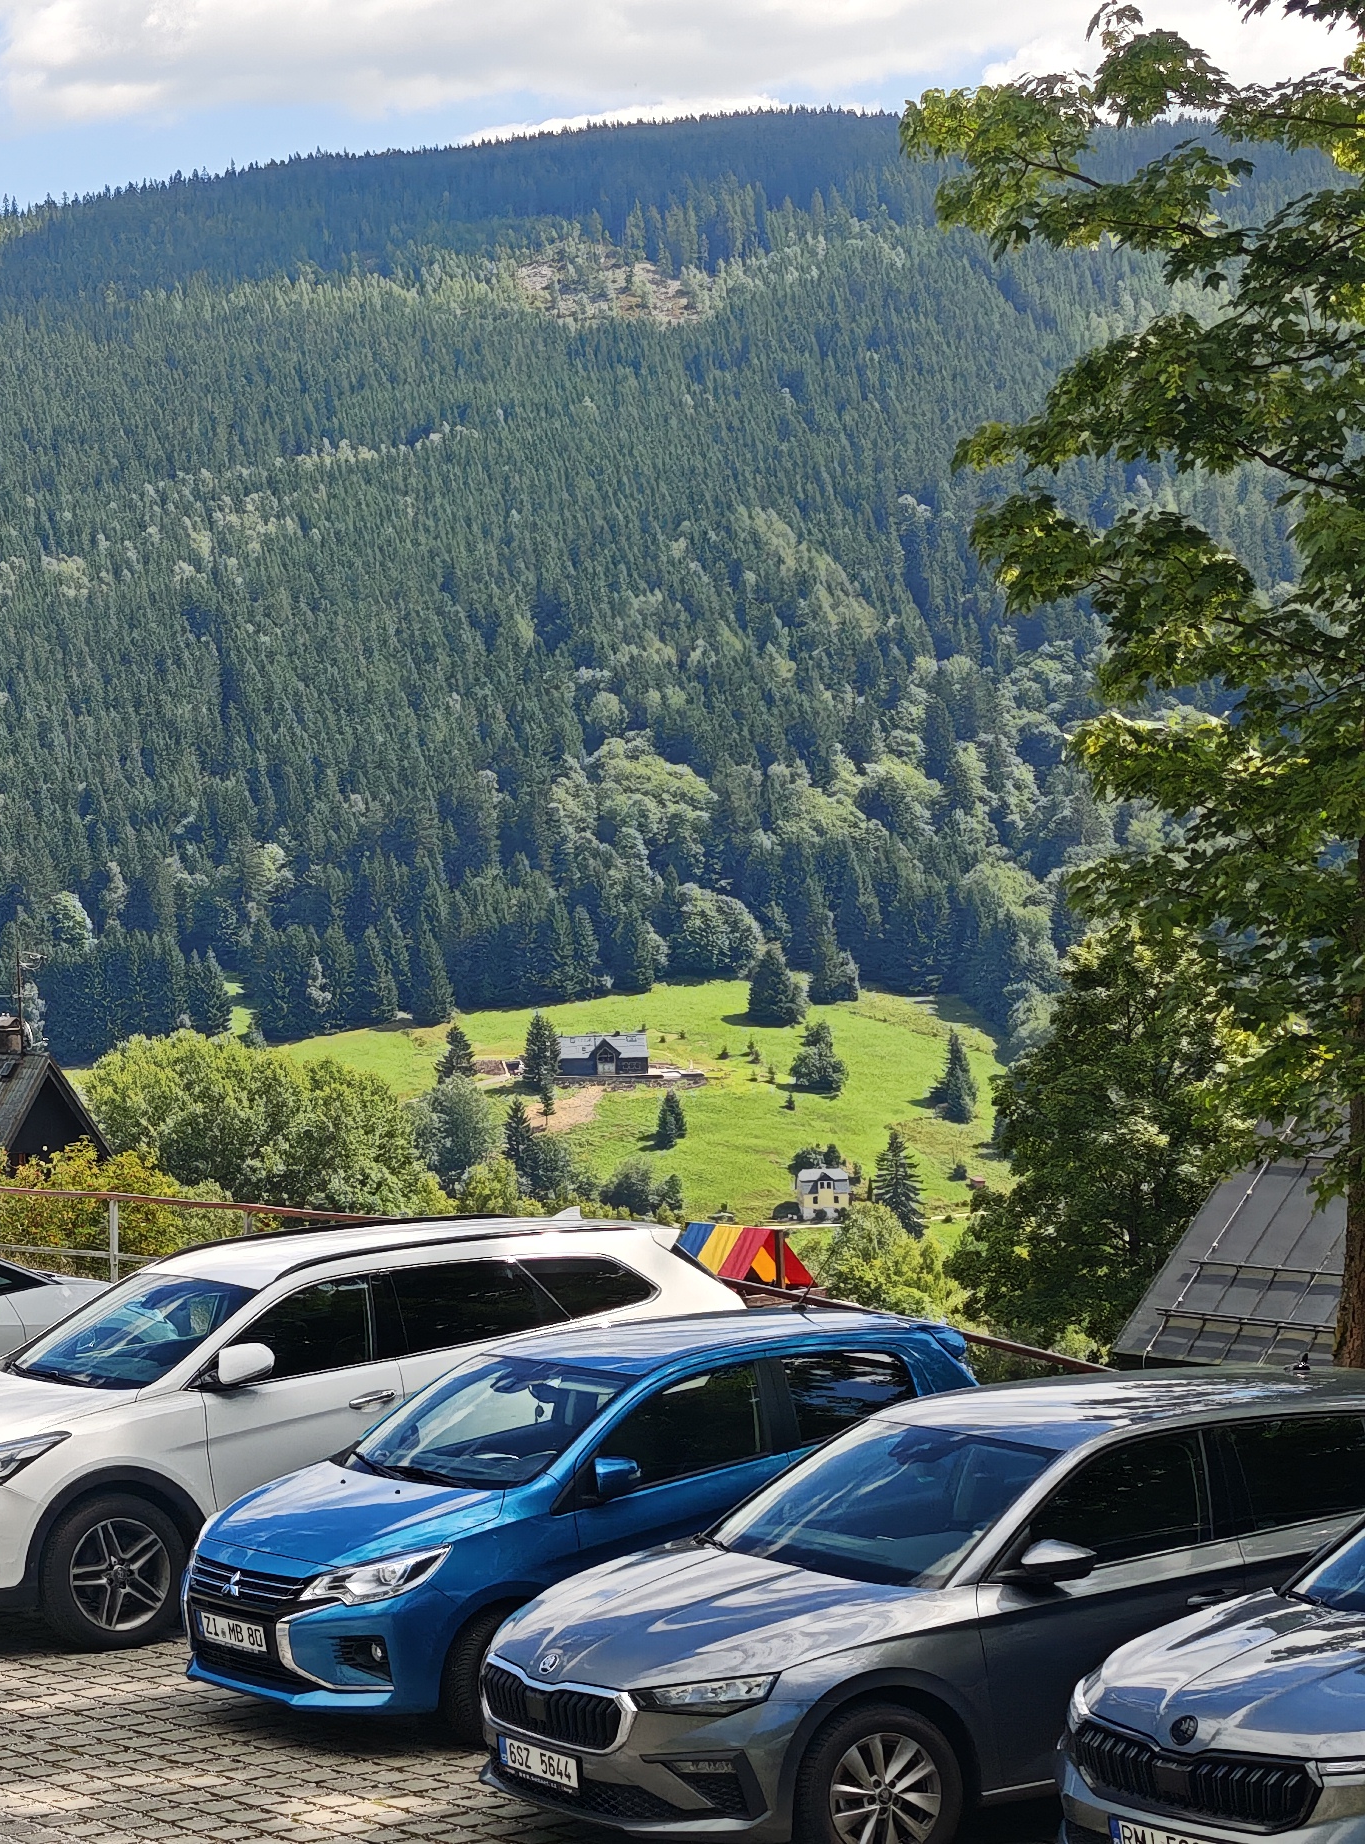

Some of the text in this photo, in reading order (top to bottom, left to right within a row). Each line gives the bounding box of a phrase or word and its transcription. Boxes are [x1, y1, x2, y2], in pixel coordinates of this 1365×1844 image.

[227, 1622, 244, 1643] MB
[247, 1626, 263, 1648] 80
[509, 1742, 531, 1770] 6SZ
[540, 1751, 572, 1783] 5644
